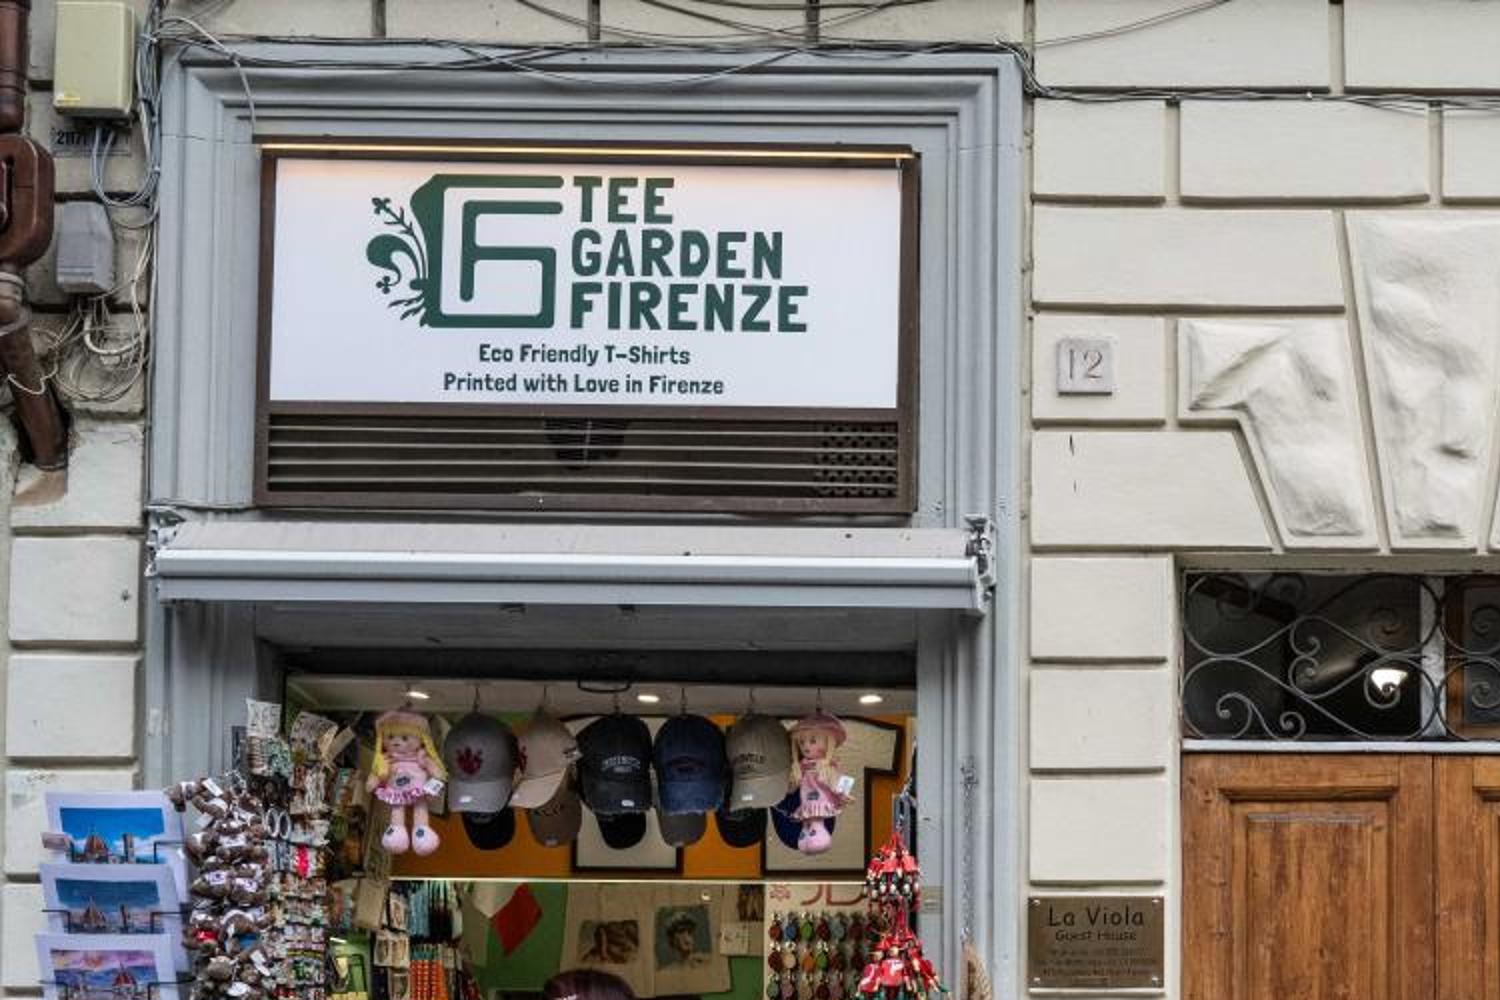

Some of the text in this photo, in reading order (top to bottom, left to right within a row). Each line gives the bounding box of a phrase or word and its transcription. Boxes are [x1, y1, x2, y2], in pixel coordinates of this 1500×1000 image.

[573, 175, 675, 225] TEE
[571, 229, 783, 280] GARDEN
[570, 281, 809, 333] FIRENZE
[479, 343, 691, 367] Eco Friendly T-Shirts
[1068, 348, 1104, 379] 12
[443, 372, 724, 395] Printed with Love in Firenze
[1048, 904, 1144, 927] La Viola
